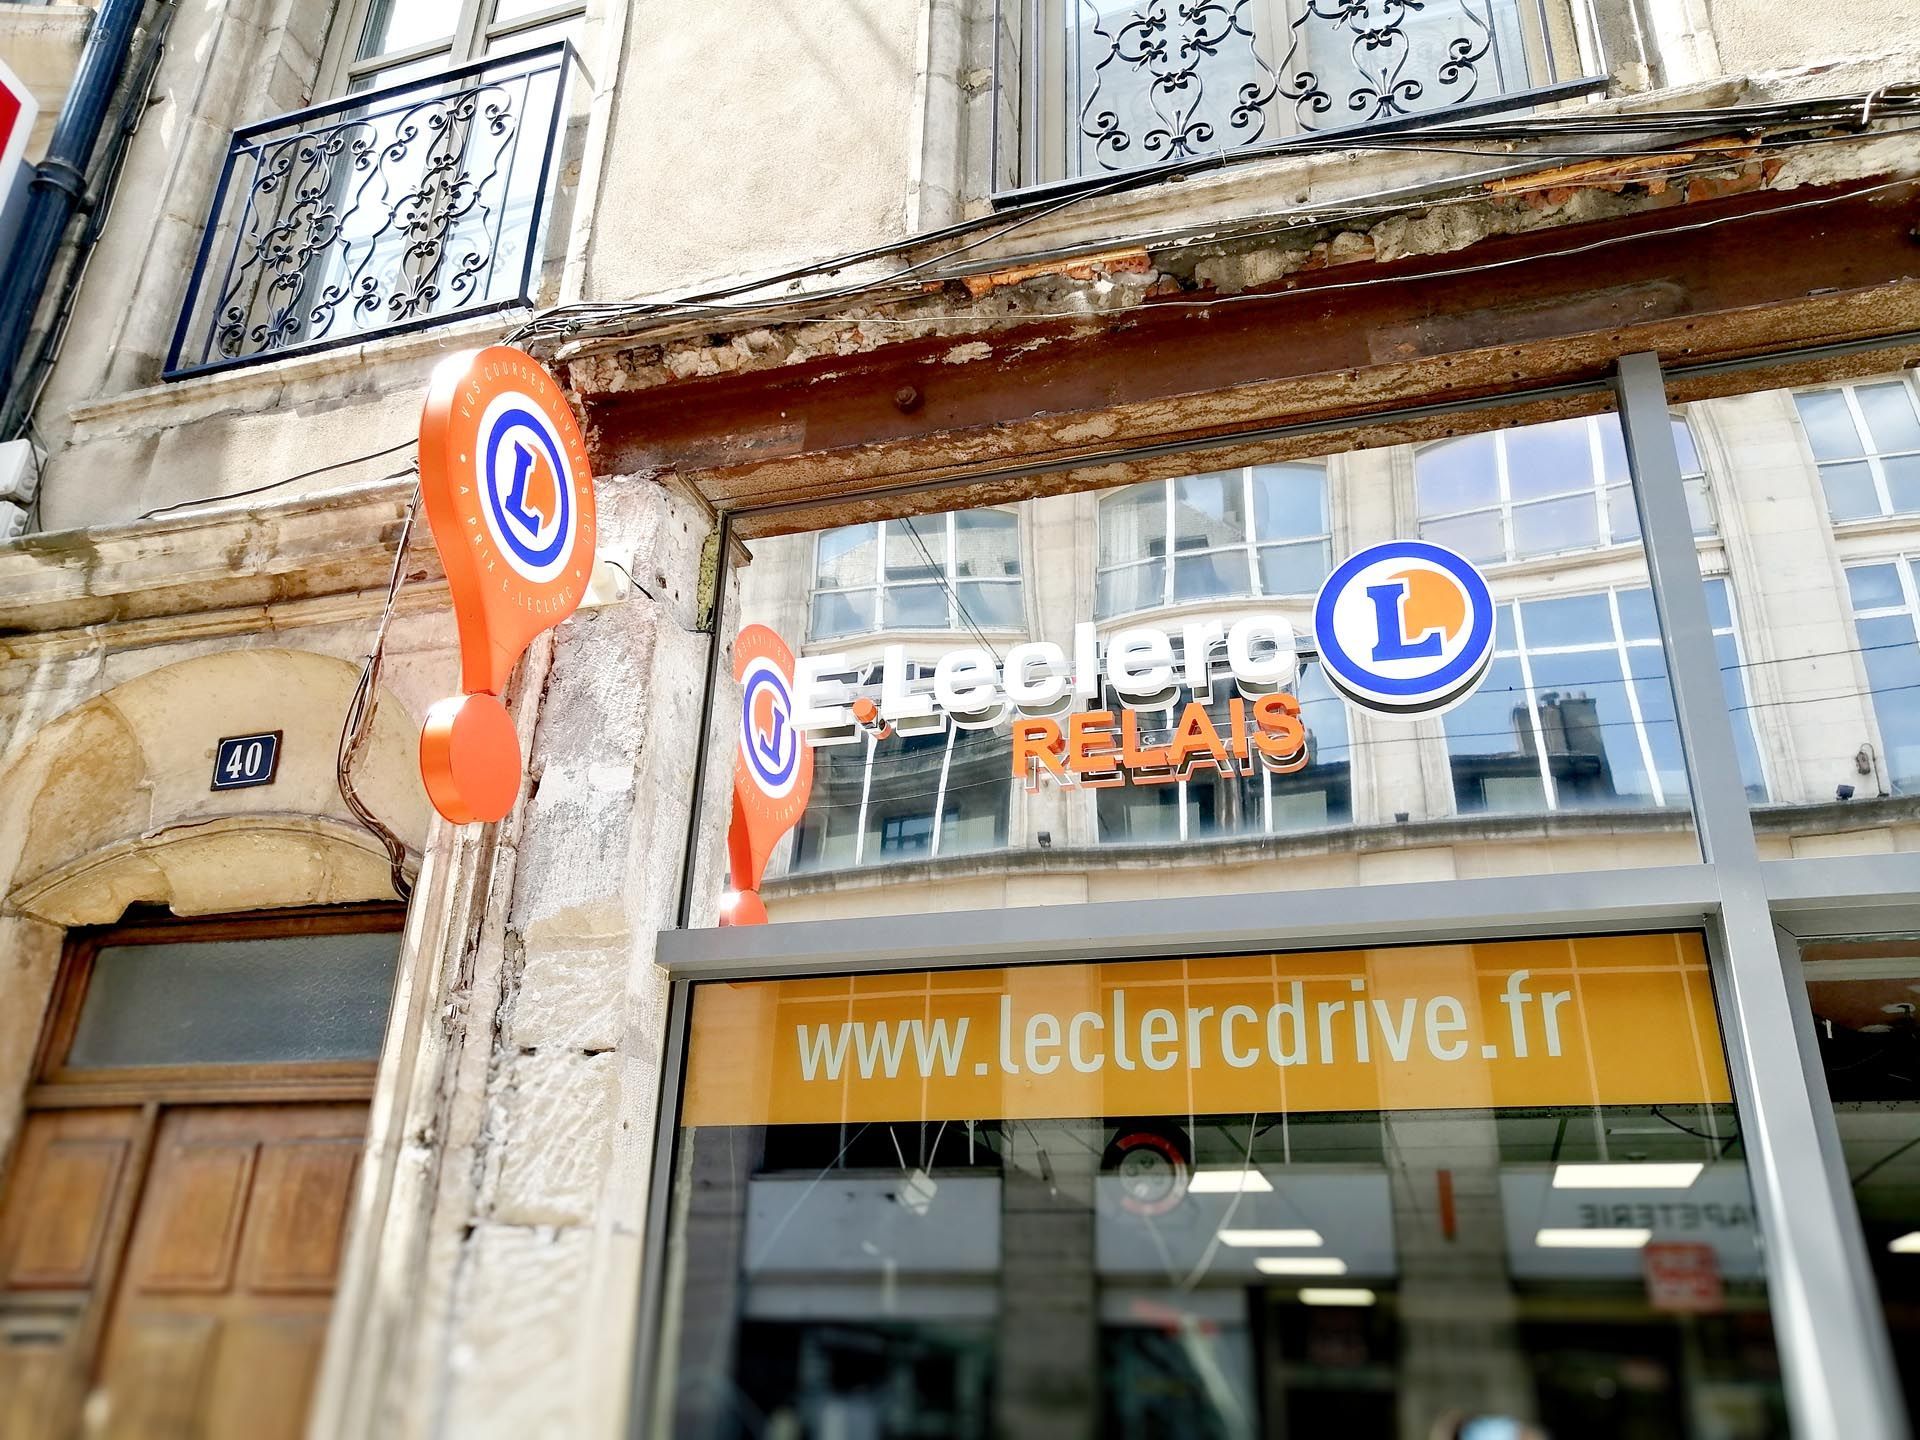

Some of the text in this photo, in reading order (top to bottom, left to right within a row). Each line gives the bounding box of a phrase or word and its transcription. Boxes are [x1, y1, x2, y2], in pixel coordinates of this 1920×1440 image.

[461, 380, 481, 418] VOS
[484, 361, 545, 394] COURSES
[583, 512, 592, 545] ICI
[467, 516, 496, 573] PRIX
[790, 615, 1297, 729] E.Leclerc
[225, 741, 263, 779] 40
[1012, 692, 1306, 779] RELAIS
[796, 969, 1571, 1081] www.leclercdrive.fr
